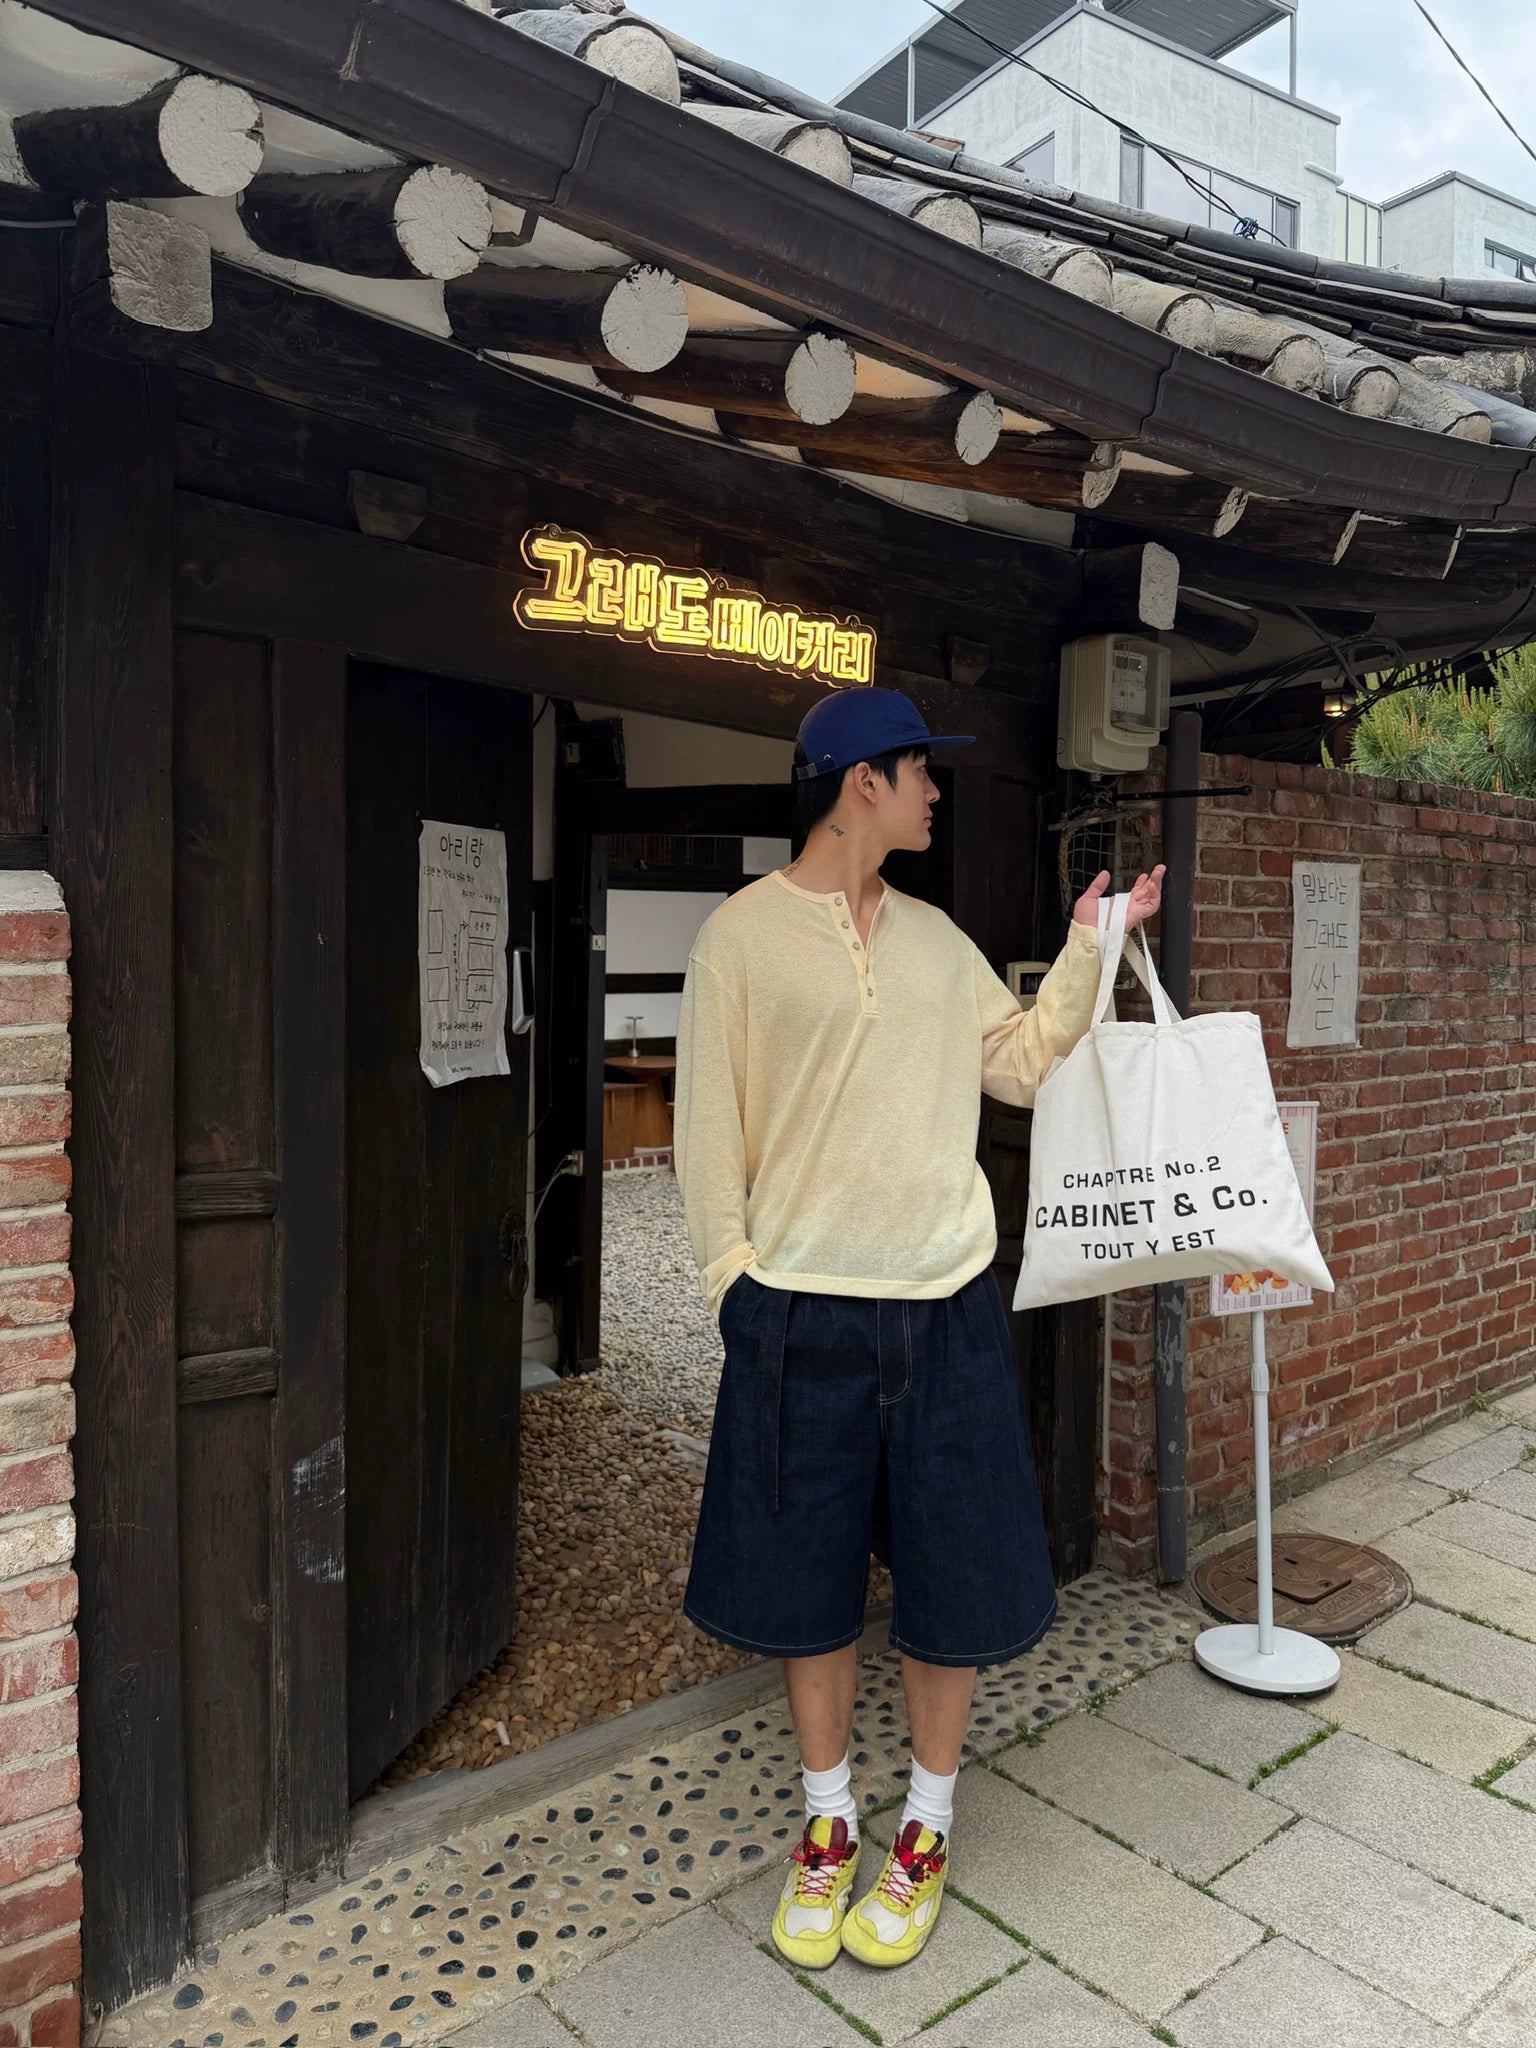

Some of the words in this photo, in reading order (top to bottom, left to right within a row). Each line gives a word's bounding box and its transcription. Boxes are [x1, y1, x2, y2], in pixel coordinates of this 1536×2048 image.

[440, 833, 484, 868] 아리랑
[1304, 919, 1348, 949] 그래도
[1308, 962, 1341, 1031] 쌀
[1063, 1167, 1155, 1189] CHAPTRE
[1165, 1156, 1221, 1178] No.2
[1036, 1199, 1155, 1228] CABINET
[1174, 1193, 1197, 1217] &
[1212, 1185, 1268, 1211] Co.
[1081, 1242, 1135, 1259] TOUT
[1146, 1240, 1159, 1256] Y
[1171, 1229, 1217, 1252] EST
